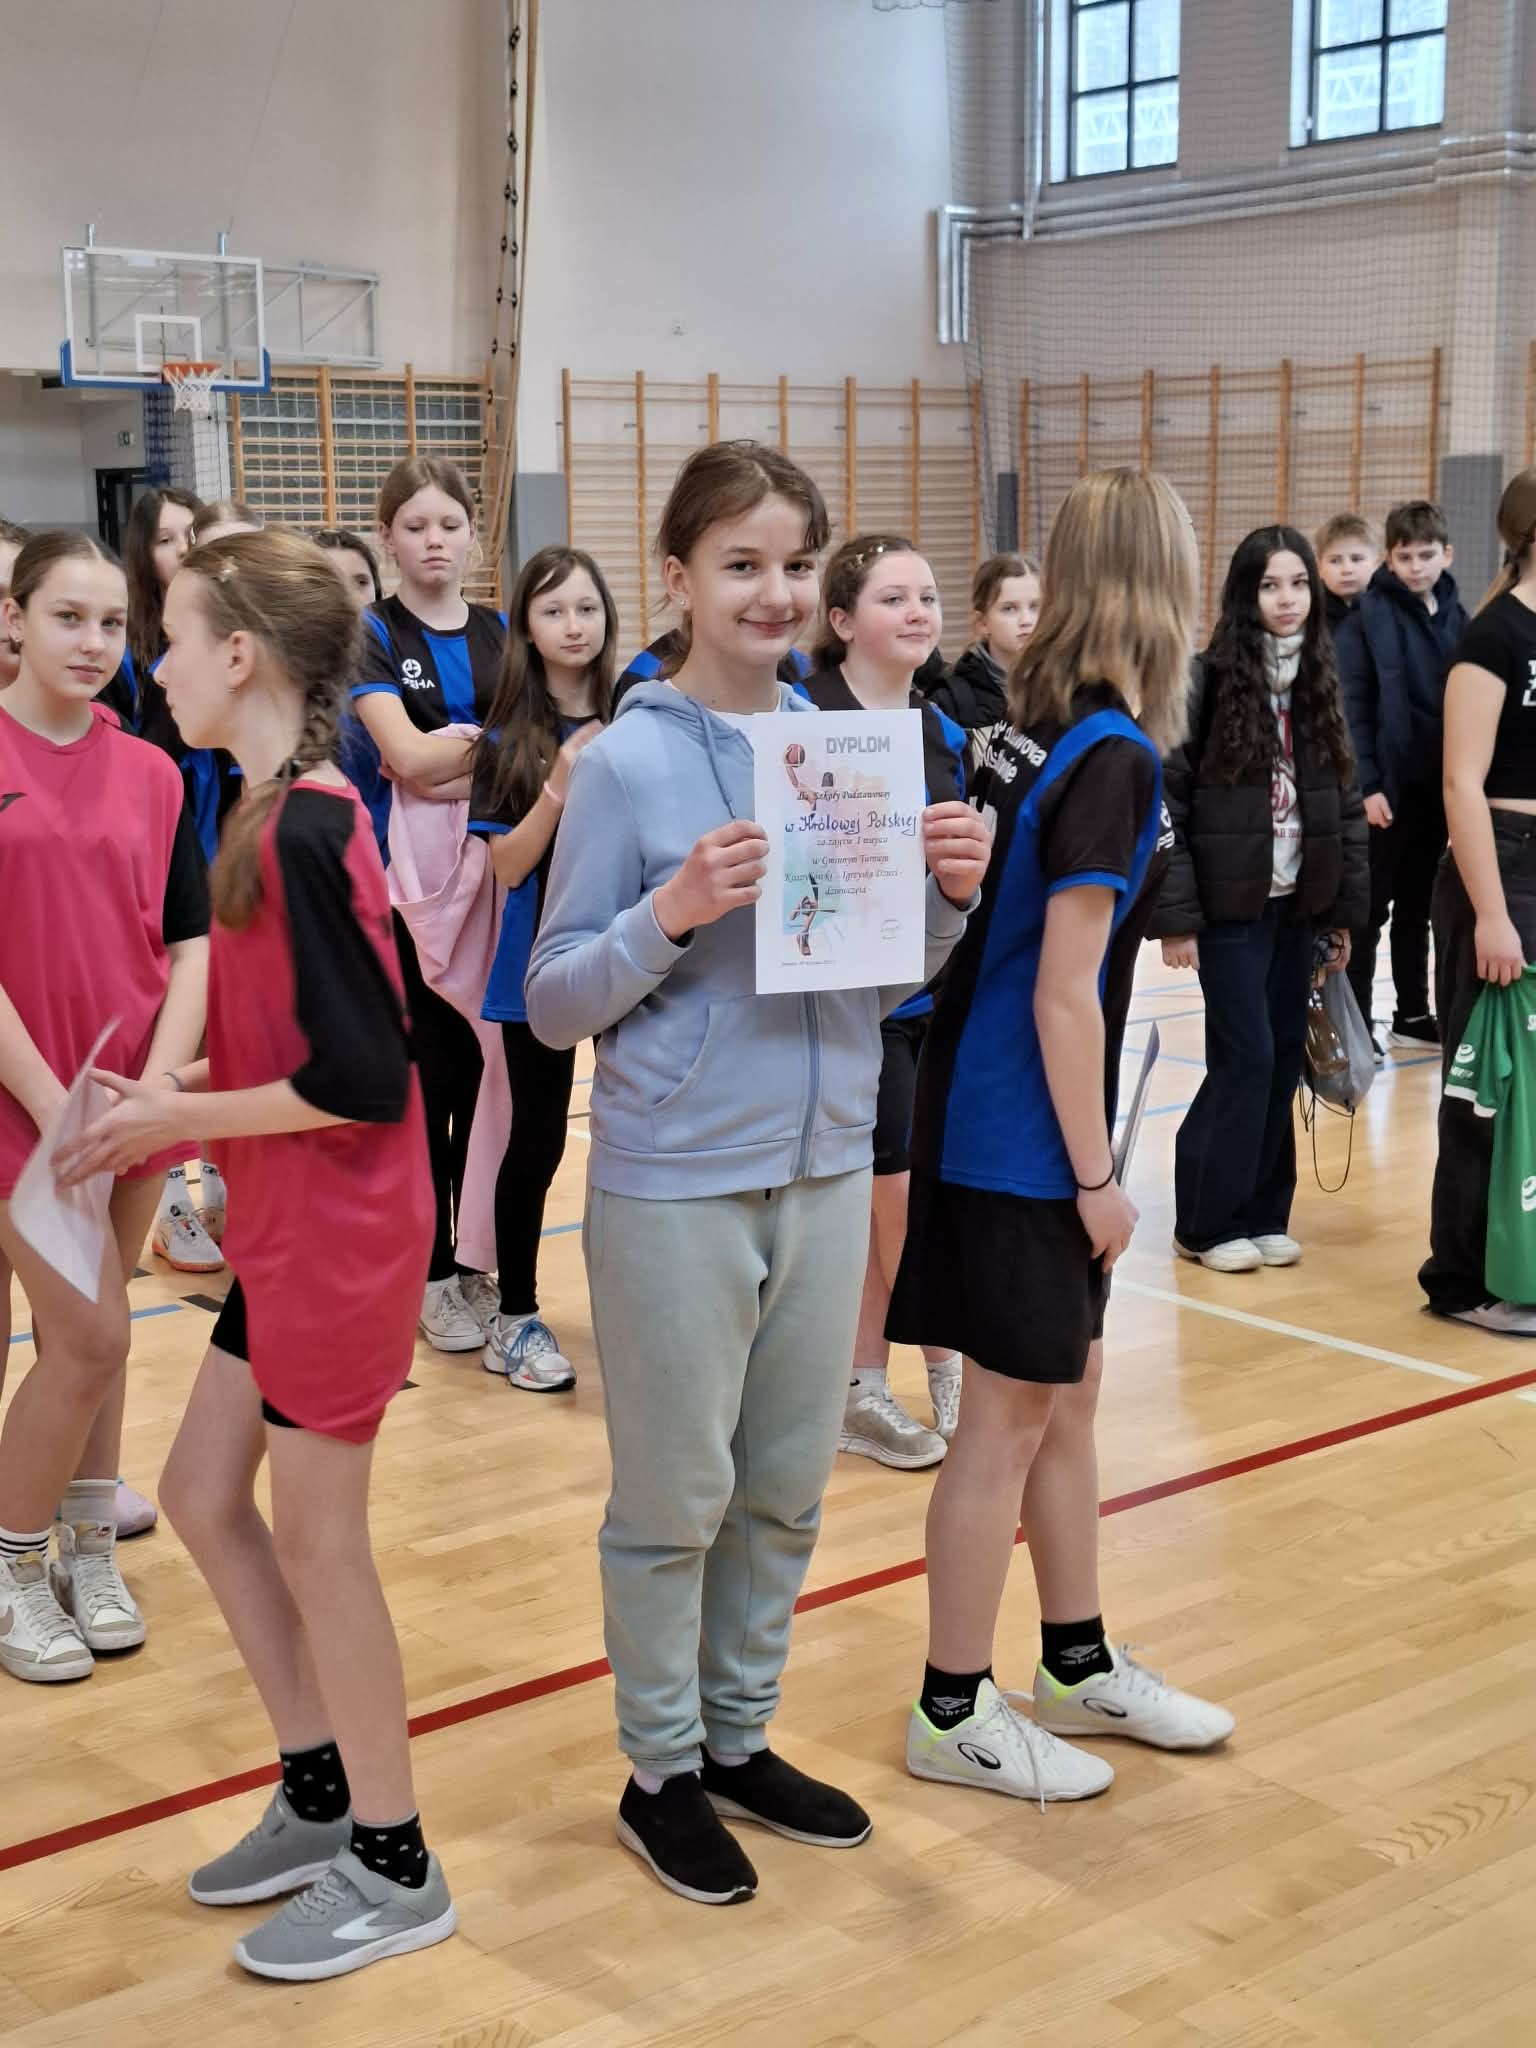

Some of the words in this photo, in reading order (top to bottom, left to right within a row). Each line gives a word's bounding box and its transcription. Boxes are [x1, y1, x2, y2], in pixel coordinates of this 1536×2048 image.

[825, 736, 891, 754] DYPLOM
[784, 822, 795, 833] w
[799, 811, 861, 835] Królowej
[866, 810, 917, 836] Polskiej
[812, 856, 821, 865] w
